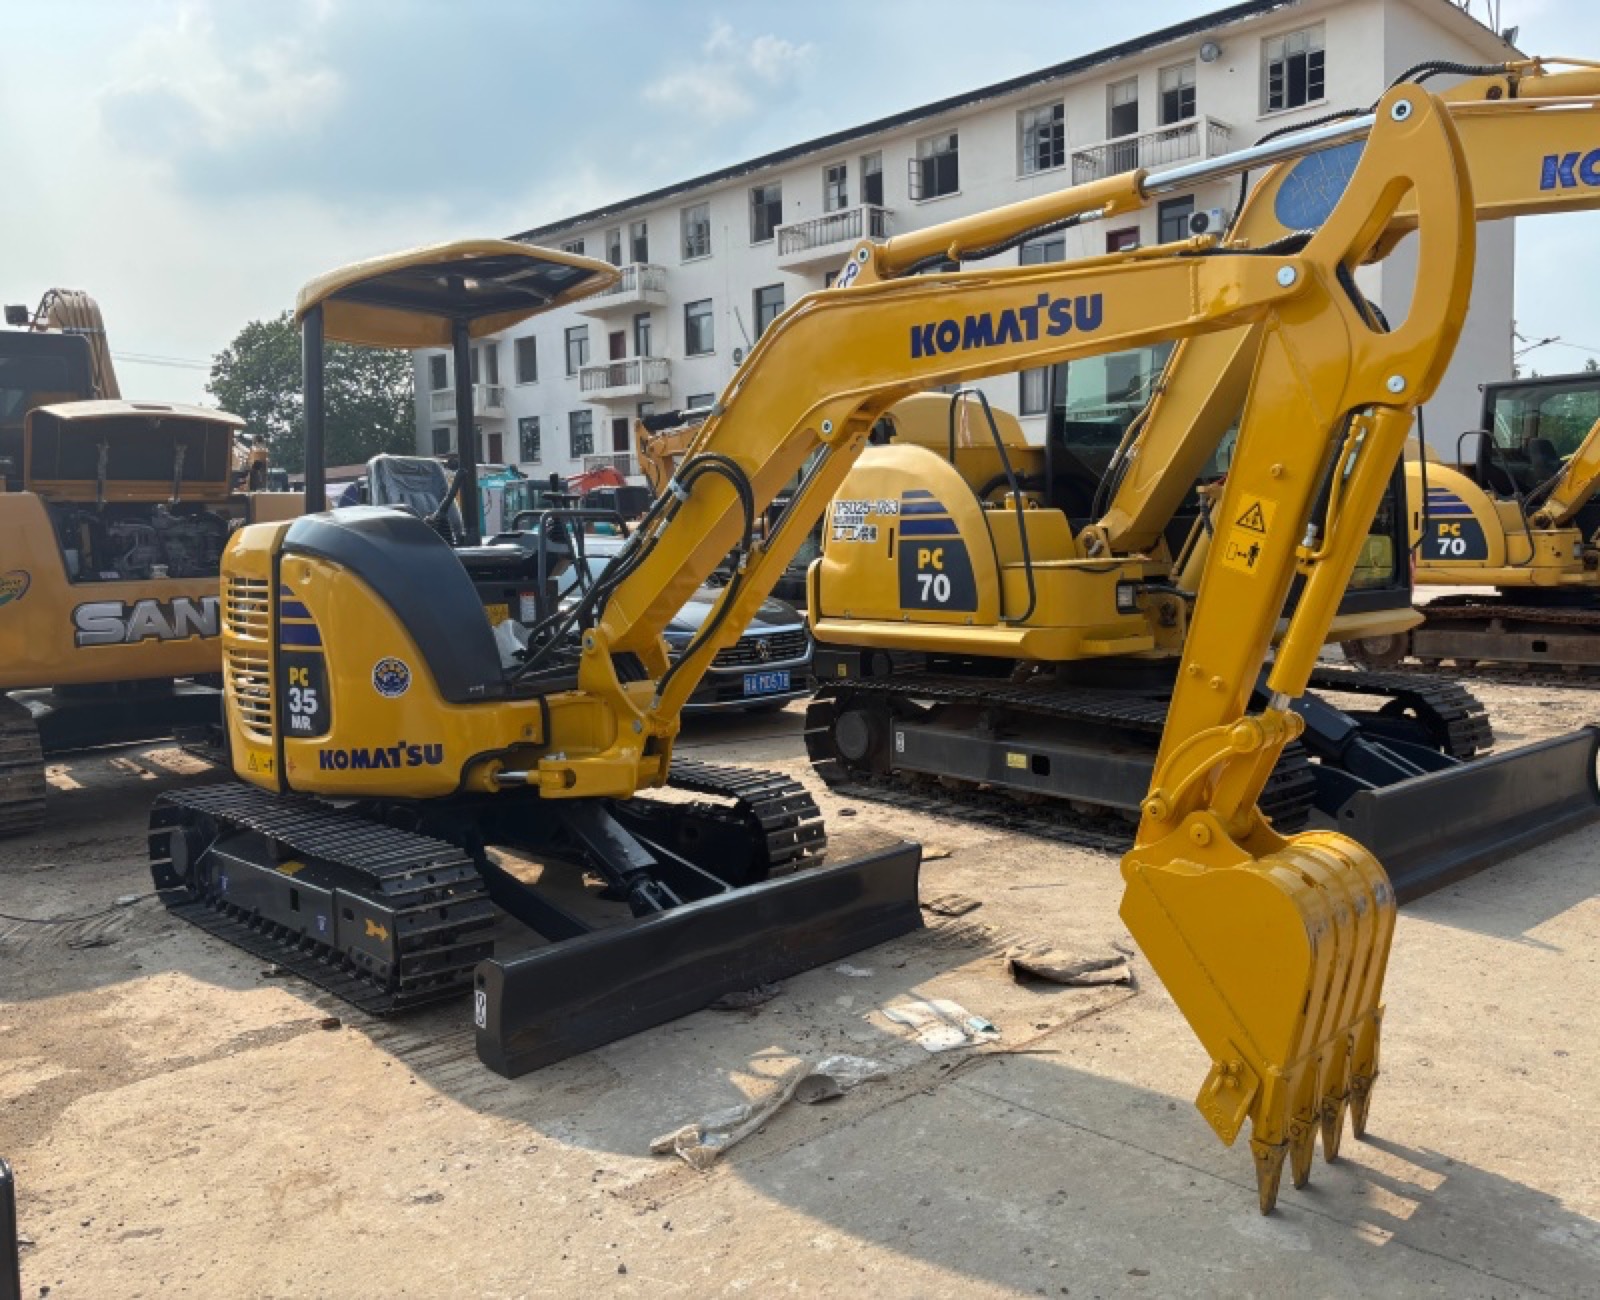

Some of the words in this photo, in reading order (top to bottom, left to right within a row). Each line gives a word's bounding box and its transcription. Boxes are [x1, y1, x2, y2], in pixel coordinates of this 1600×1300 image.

[911, 292, 1103, 359] KOMATSU
[1437, 523, 1461, 537] PC
[1437, 537, 1467, 556] 70
[917, 548, 943, 570] PC
[916, 573, 951, 602] 70
[289, 667, 309, 687] PC
[288, 687, 318, 714] 35
[291, 714, 312, 730] MR
[319, 741, 443, 770] KOMATSU
